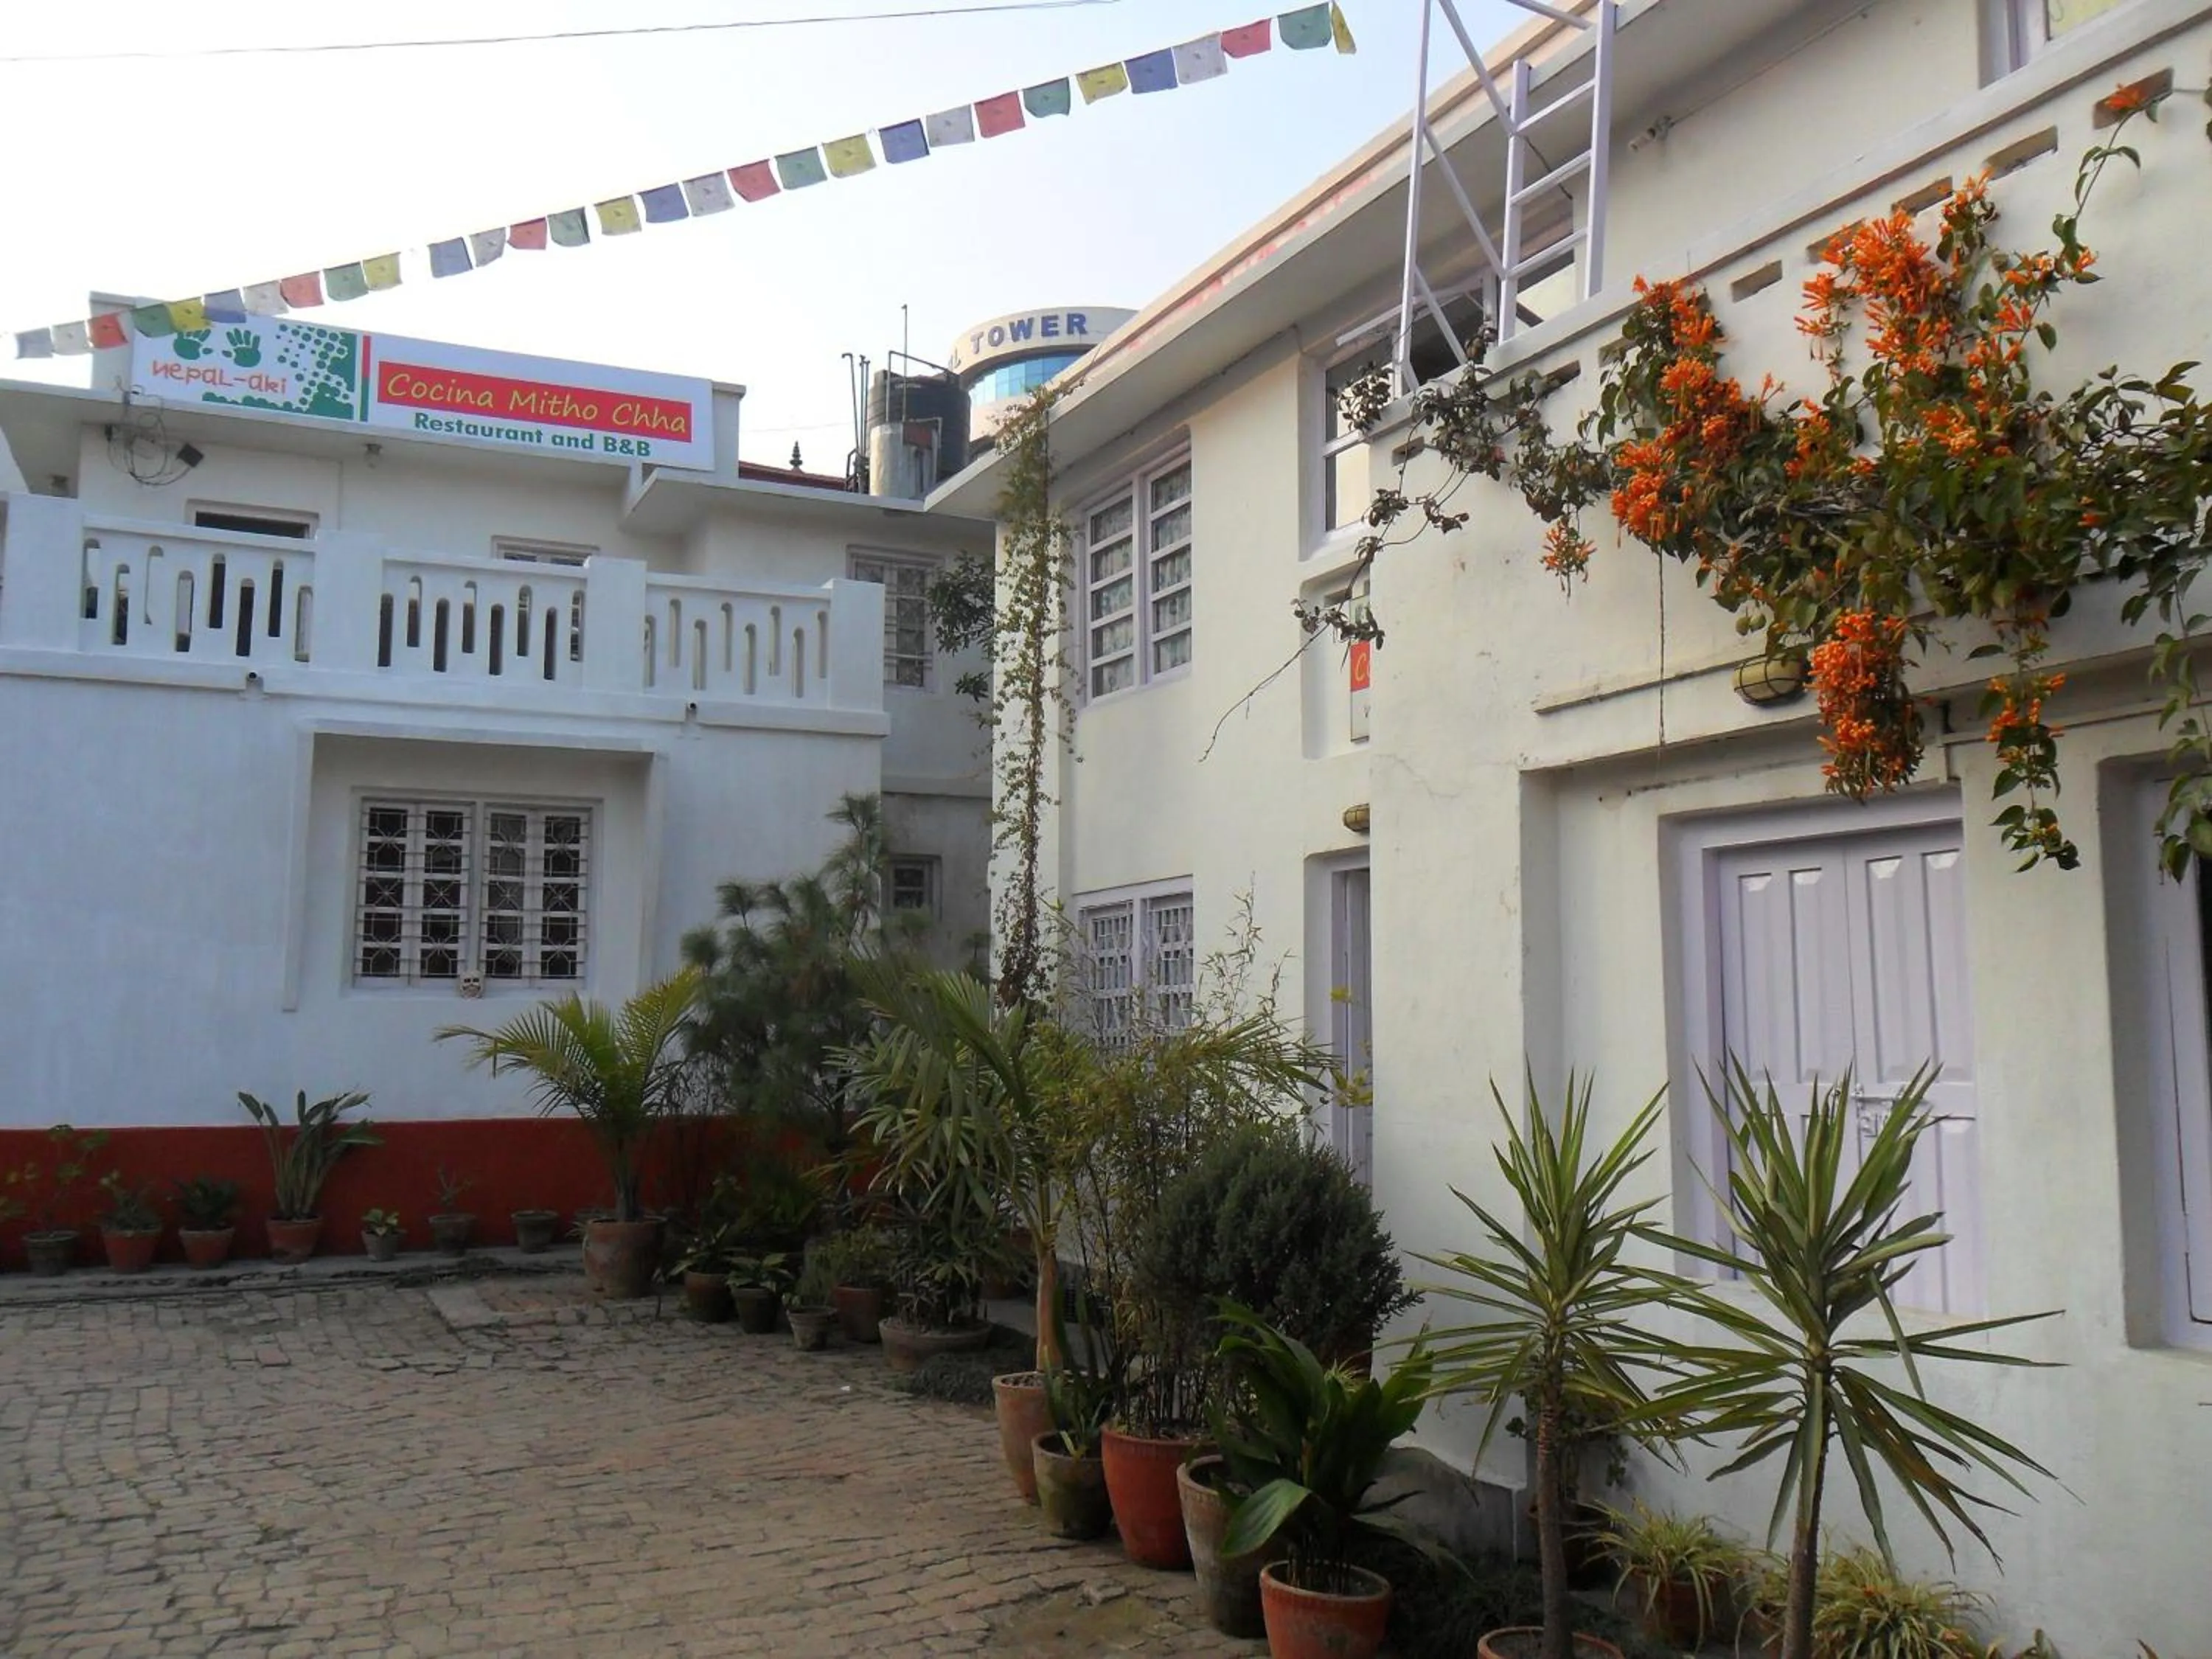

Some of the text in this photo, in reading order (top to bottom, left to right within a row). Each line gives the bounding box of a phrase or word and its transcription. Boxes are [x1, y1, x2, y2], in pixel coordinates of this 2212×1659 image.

[970, 312, 1088, 355] TOWER
[386, 373, 685, 432] Cocina Mitho Chha
[414, 411, 650, 456] Restaurant and B&B
